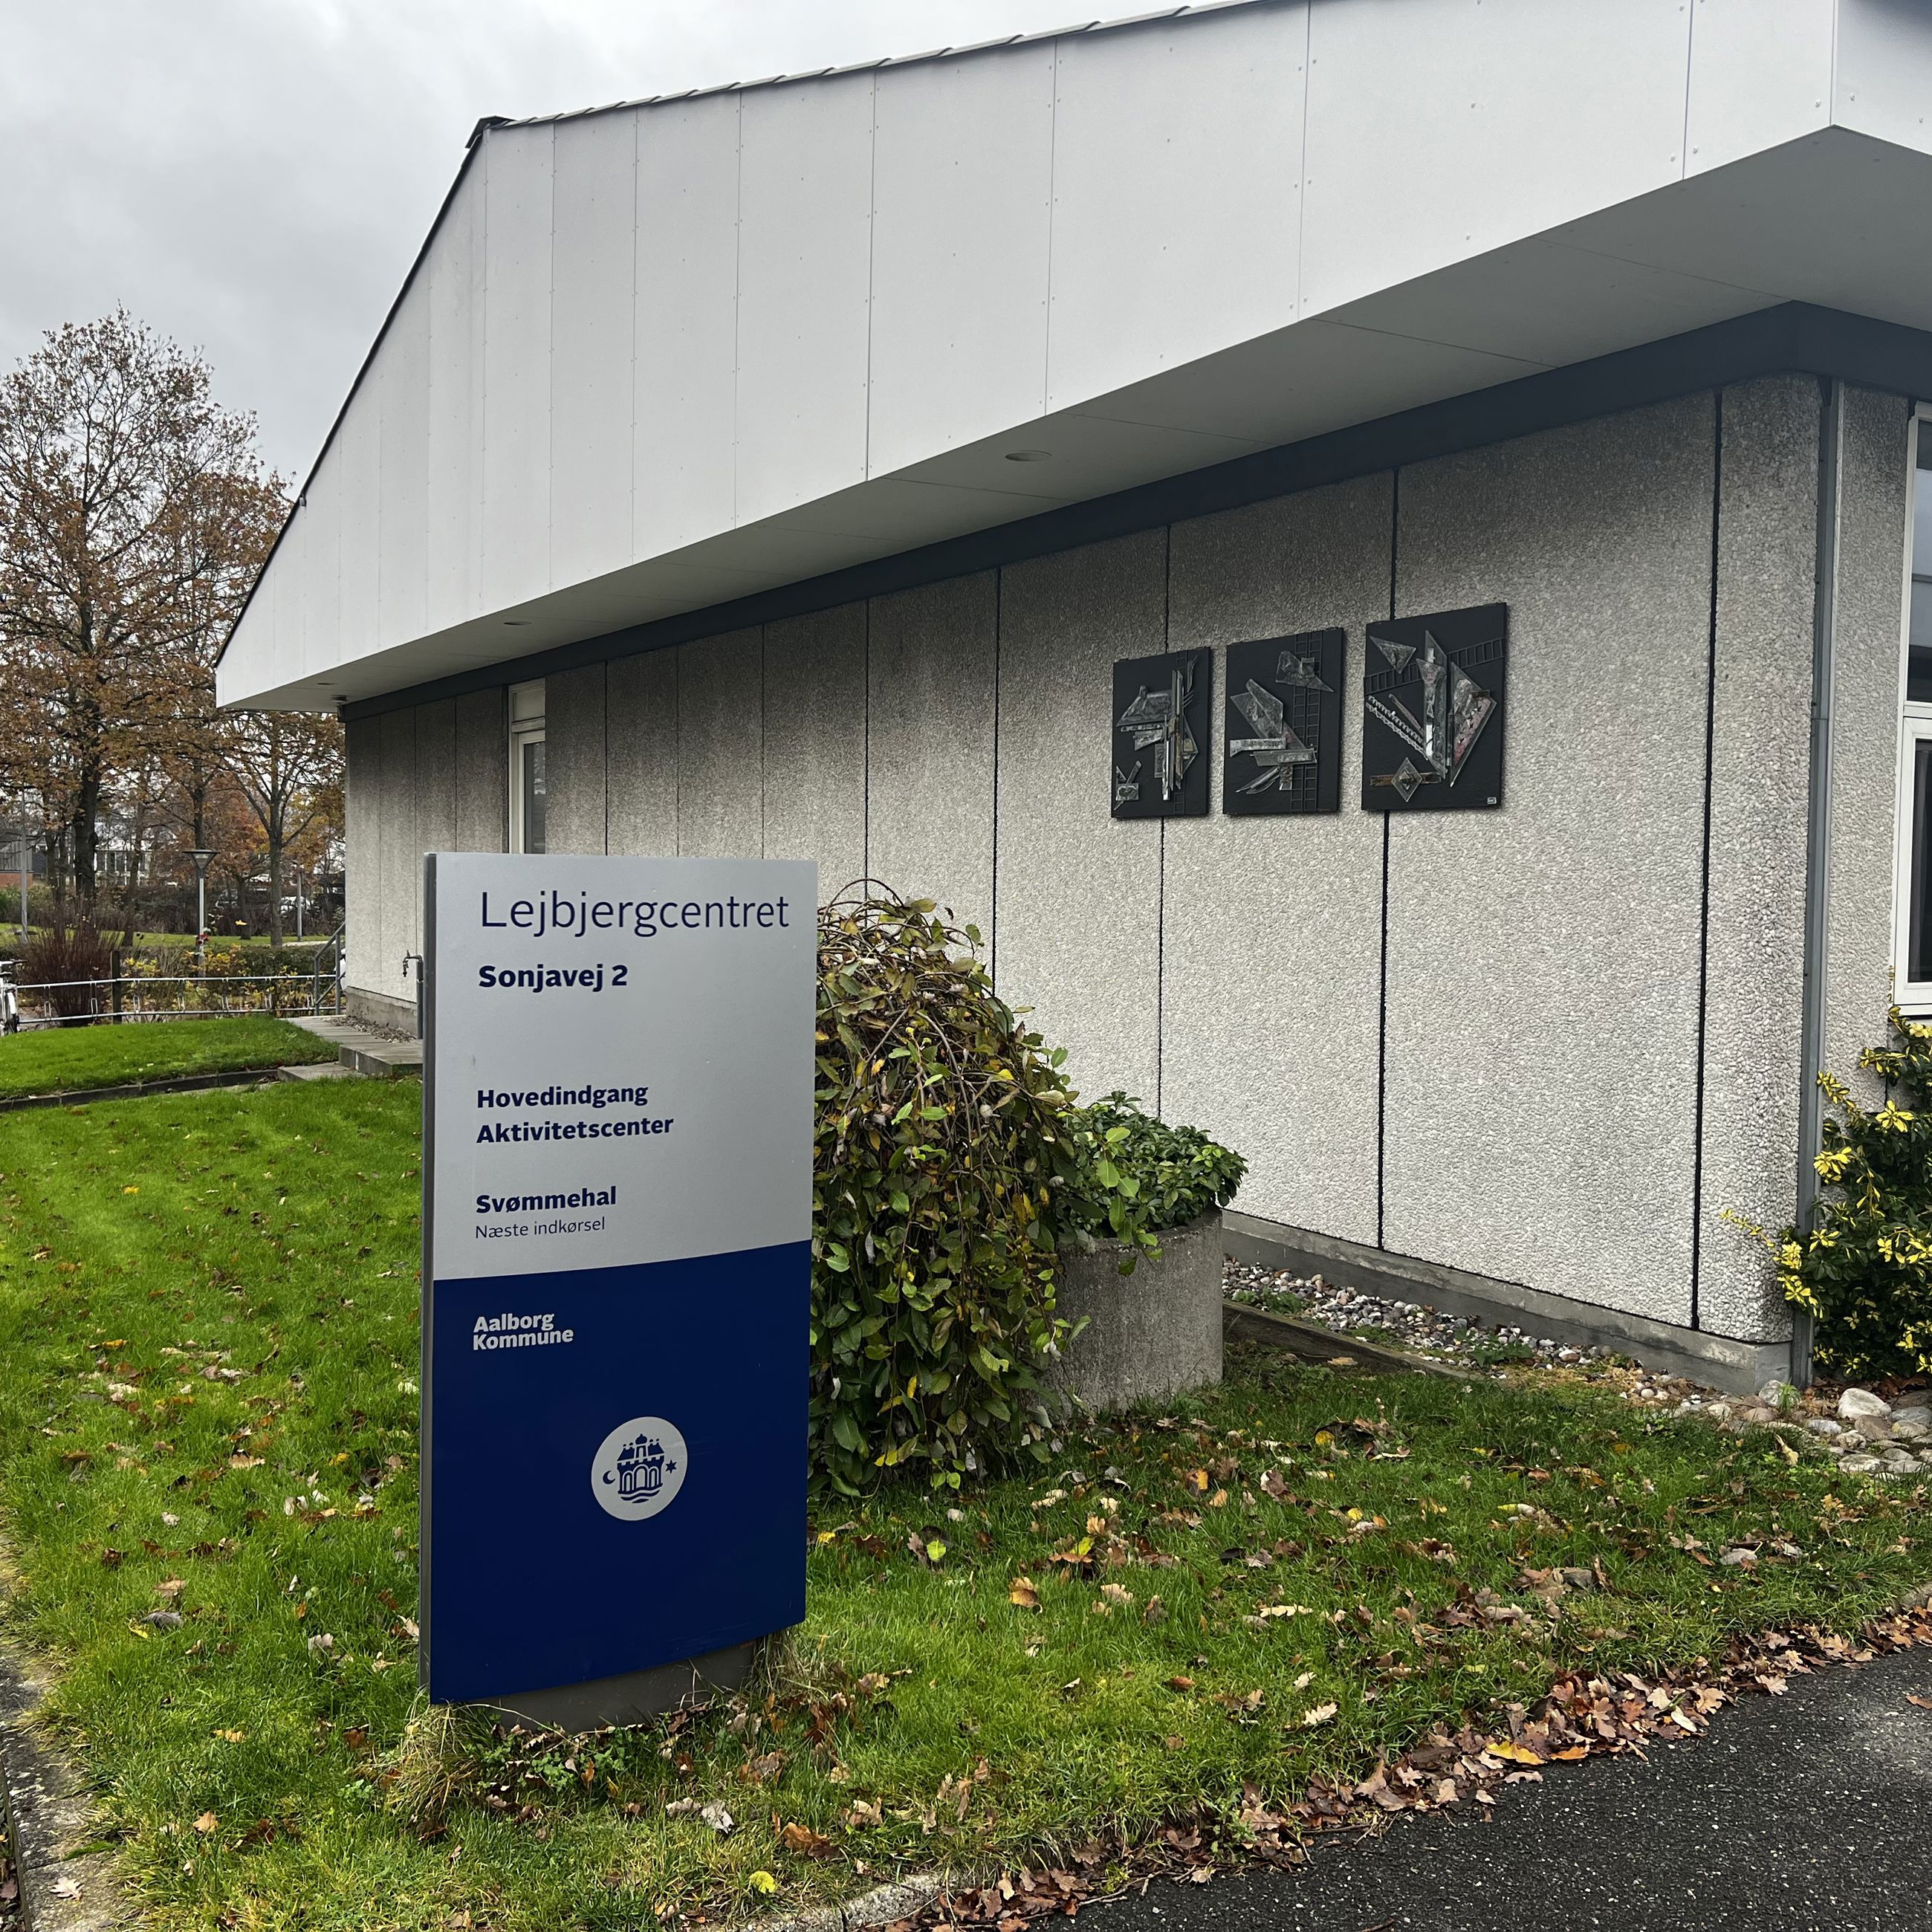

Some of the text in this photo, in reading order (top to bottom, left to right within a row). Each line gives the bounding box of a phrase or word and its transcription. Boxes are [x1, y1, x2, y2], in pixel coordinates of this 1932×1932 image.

[482, 890, 790, 938] Lejbjergcentret
[479, 964, 628, 993] Sonjavej 2
[477, 1085, 649, 1109] Hovedindgang
[476, 1118, 675, 1144] Aktivitetscenter
[476, 1186, 616, 1213] Svømmehal
[476, 1216, 605, 1239] Næste indkørsel
[473, 1313, 555, 1333] Aalborg
[473, 1329, 574, 1350] Kommune
